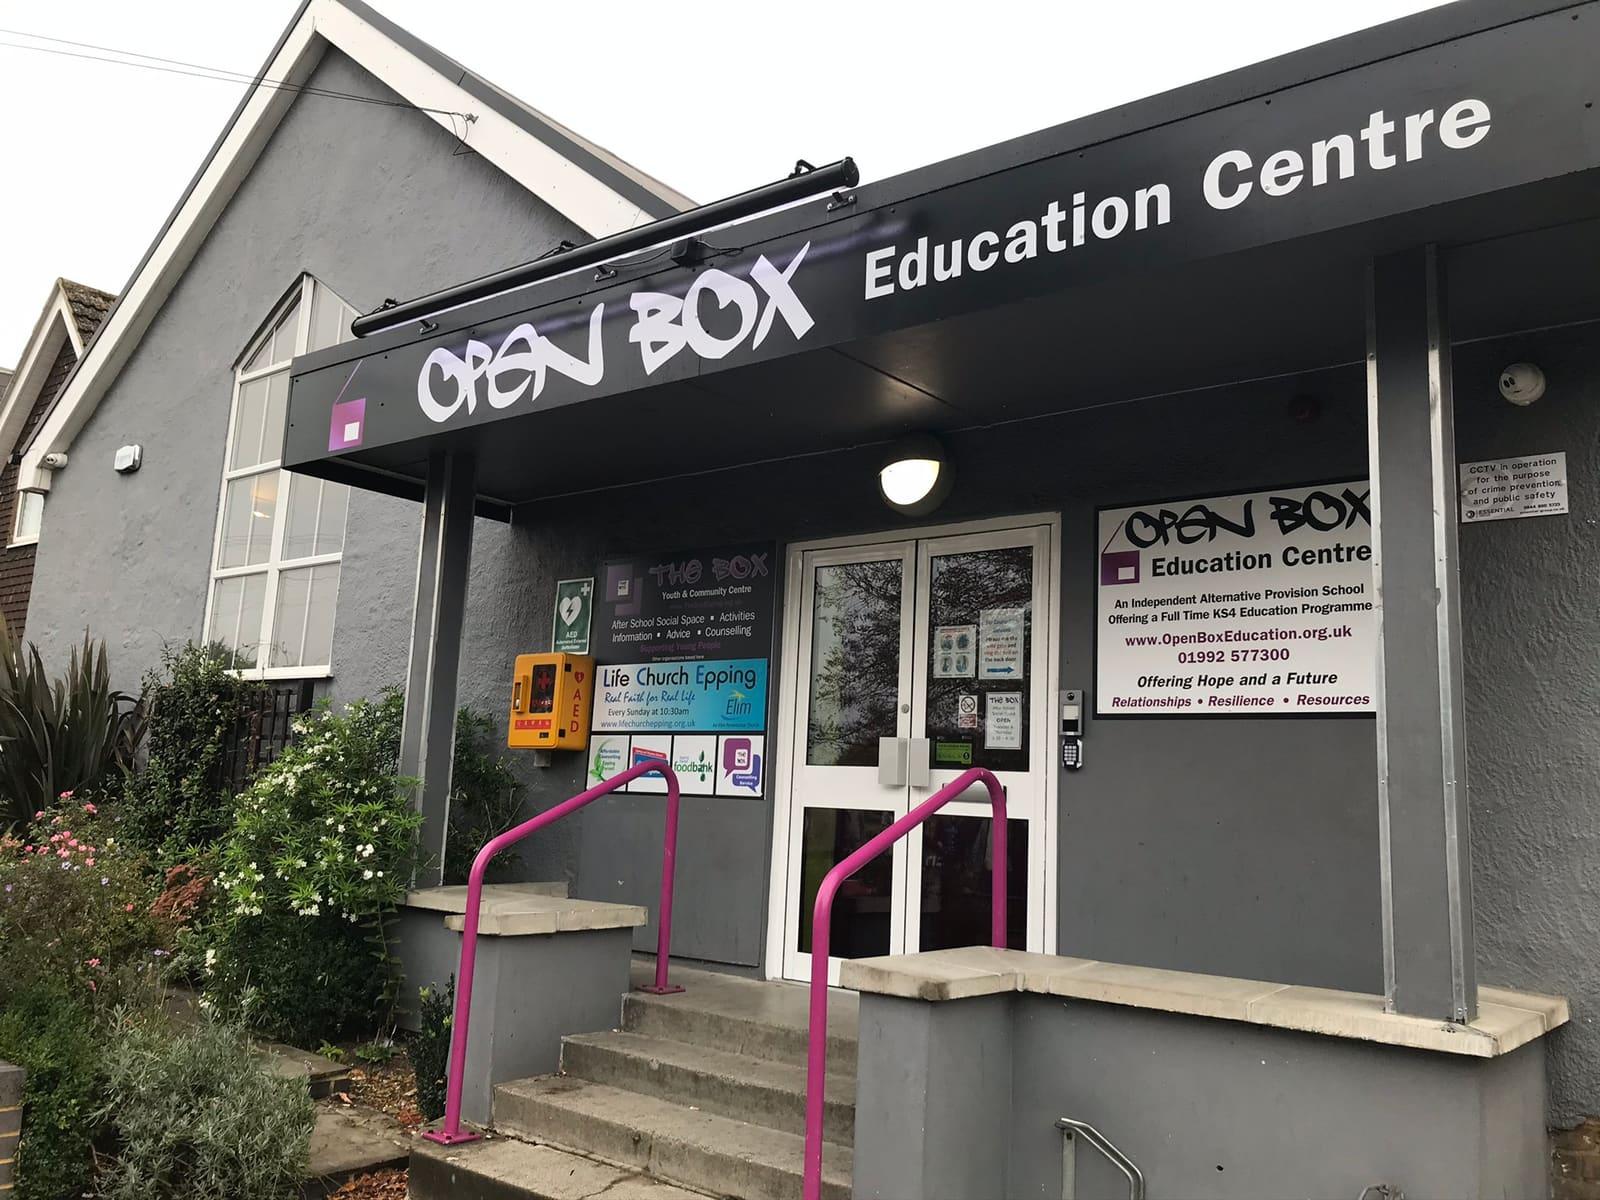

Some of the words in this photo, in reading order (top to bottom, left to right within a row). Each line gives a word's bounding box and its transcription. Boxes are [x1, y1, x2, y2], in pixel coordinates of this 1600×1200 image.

[864, 182, 1171, 300] Education
[1203, 99, 1491, 210] Centre
[418, 302, 605, 422] OPEN
[629, 241, 815, 375] BOX
[1469, 464, 1496, 474] CCTV
[1511, 458, 1557, 470] operation
[1476, 476, 1490, 484] for
[1494, 474, 1508, 482] the
[1512, 470, 1550, 481] purpose
[1481, 485, 1506, 494] crime
[1510, 480, 1560, 491] prevention
[1473, 497, 1489, 506] and
[1493, 494, 1520, 504] public
[1524, 491, 1555, 500] safety
[1125, 500, 1255, 548] OPEN
[1269, 488, 1371, 535] BOX
[1478, 507, 1514, 516] ESSENTIAL
[1152, 552, 1271, 577] Education
[1282, 544, 1372, 567] Centre
[649, 559, 702, 587] THE
[712, 552, 768, 582] BOX
[662, 590, 680, 600] Youth
[682, 589, 688, 598] &
[689, 586, 727, 598] Community
[728, 585, 752, 594] Centre
[1114, 598, 1128, 609] An
[1131, 594, 1197, 609] Independent
[1199, 591, 1261, 604] Alternative
[1265, 587, 1318, 600] Provision
[1322, 583, 1364, 596] School
[611, 619, 628, 630] After
[630, 616, 655, 627] School
[656, 615, 680, 626] Social
[681, 614, 705, 627] Space
[719, 611, 756, 622] Activities
[1108, 611, 1148, 625] Offering
[1151, 614, 1158, 622] a
[1161, 610, 1181, 622] Full
[1183, 608, 1209, 621] Time
[1213, 608, 1236, 619] KS4
[1240, 604, 1297, 617] Education
[1301, 601, 1372, 615] Programme
[612, 631, 653, 643] Information
[666, 629, 691, 639] Advice
[705, 625, 752, 637] Counselling
[1125, 625, 1352, 646] www.OpenBoxEducation.org.uk
[1178, 651, 1225, 664] 01992
[1230, 648, 1290, 662] 577300
[603, 667, 630, 687] Life
[636, 665, 688, 686] Church
[696, 664, 756, 691] Epping
[1137, 674, 1192, 690] Offering
[1197, 674, 1234, 689] Hope
[1239, 673, 1267, 686] and
[1272, 675, 1281, 685] a
[1286, 671, 1338, 685] Future
[604, 692, 622, 703] Real
[623, 691, 645, 703] Faith
[646, 691, 658, 706] for
[661, 690, 679, 702] Real
[681, 690, 696, 704] Life
[726, 698, 751, 715] Elim
[1005, 696, 1019, 704] BOX
[1112, 696, 1191, 708] Relationships
[1208, 695, 1274, 707] Resilience
[1296, 693, 1370, 706] Resources
[570, 688, 582, 733] AED
[608, 708, 625, 717] Every
[626, 707, 650, 717] Sunday
[660, 707, 689, 716] 10:30am
[600, 719, 696, 729] www.lifechurchepping.org.uk
[673, 761, 713, 773] foodbank
